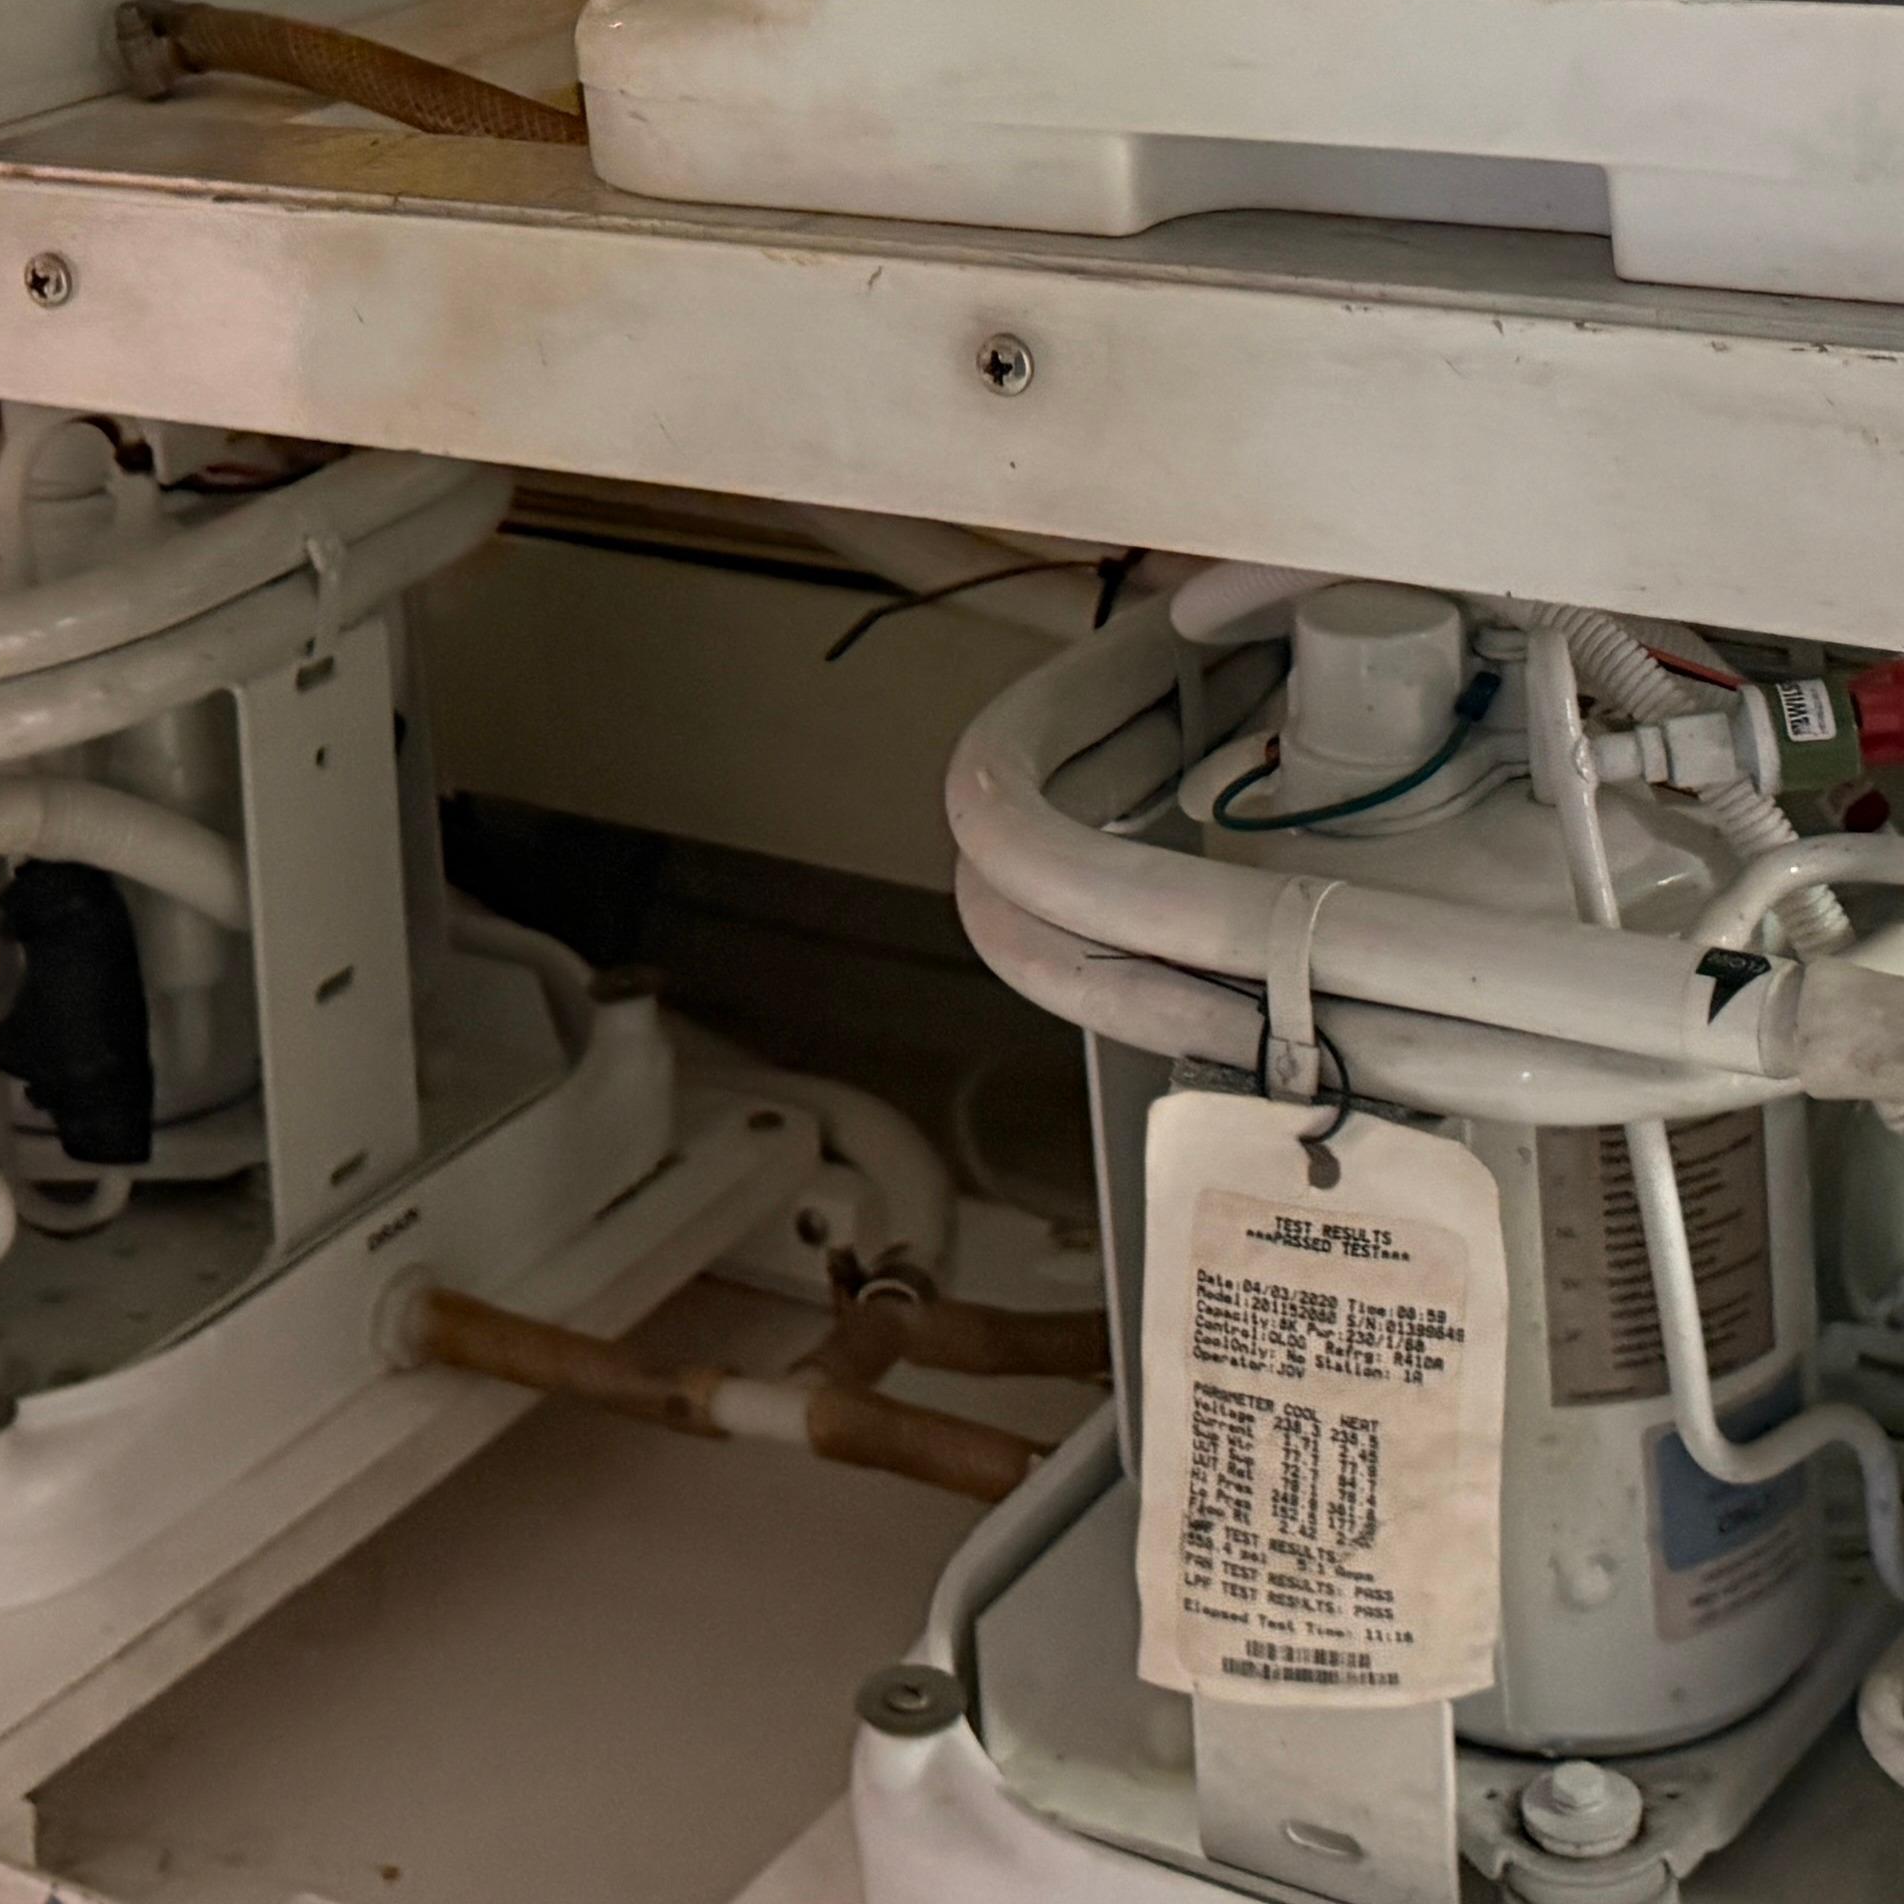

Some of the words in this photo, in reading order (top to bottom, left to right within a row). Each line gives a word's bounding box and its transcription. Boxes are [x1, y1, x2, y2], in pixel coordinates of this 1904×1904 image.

[1275, 1216, 1312, 1236] TEST
[1321, 1223, 1393, 1246] RESULTS
[1282, 1402, 1322, 1424] COOL
